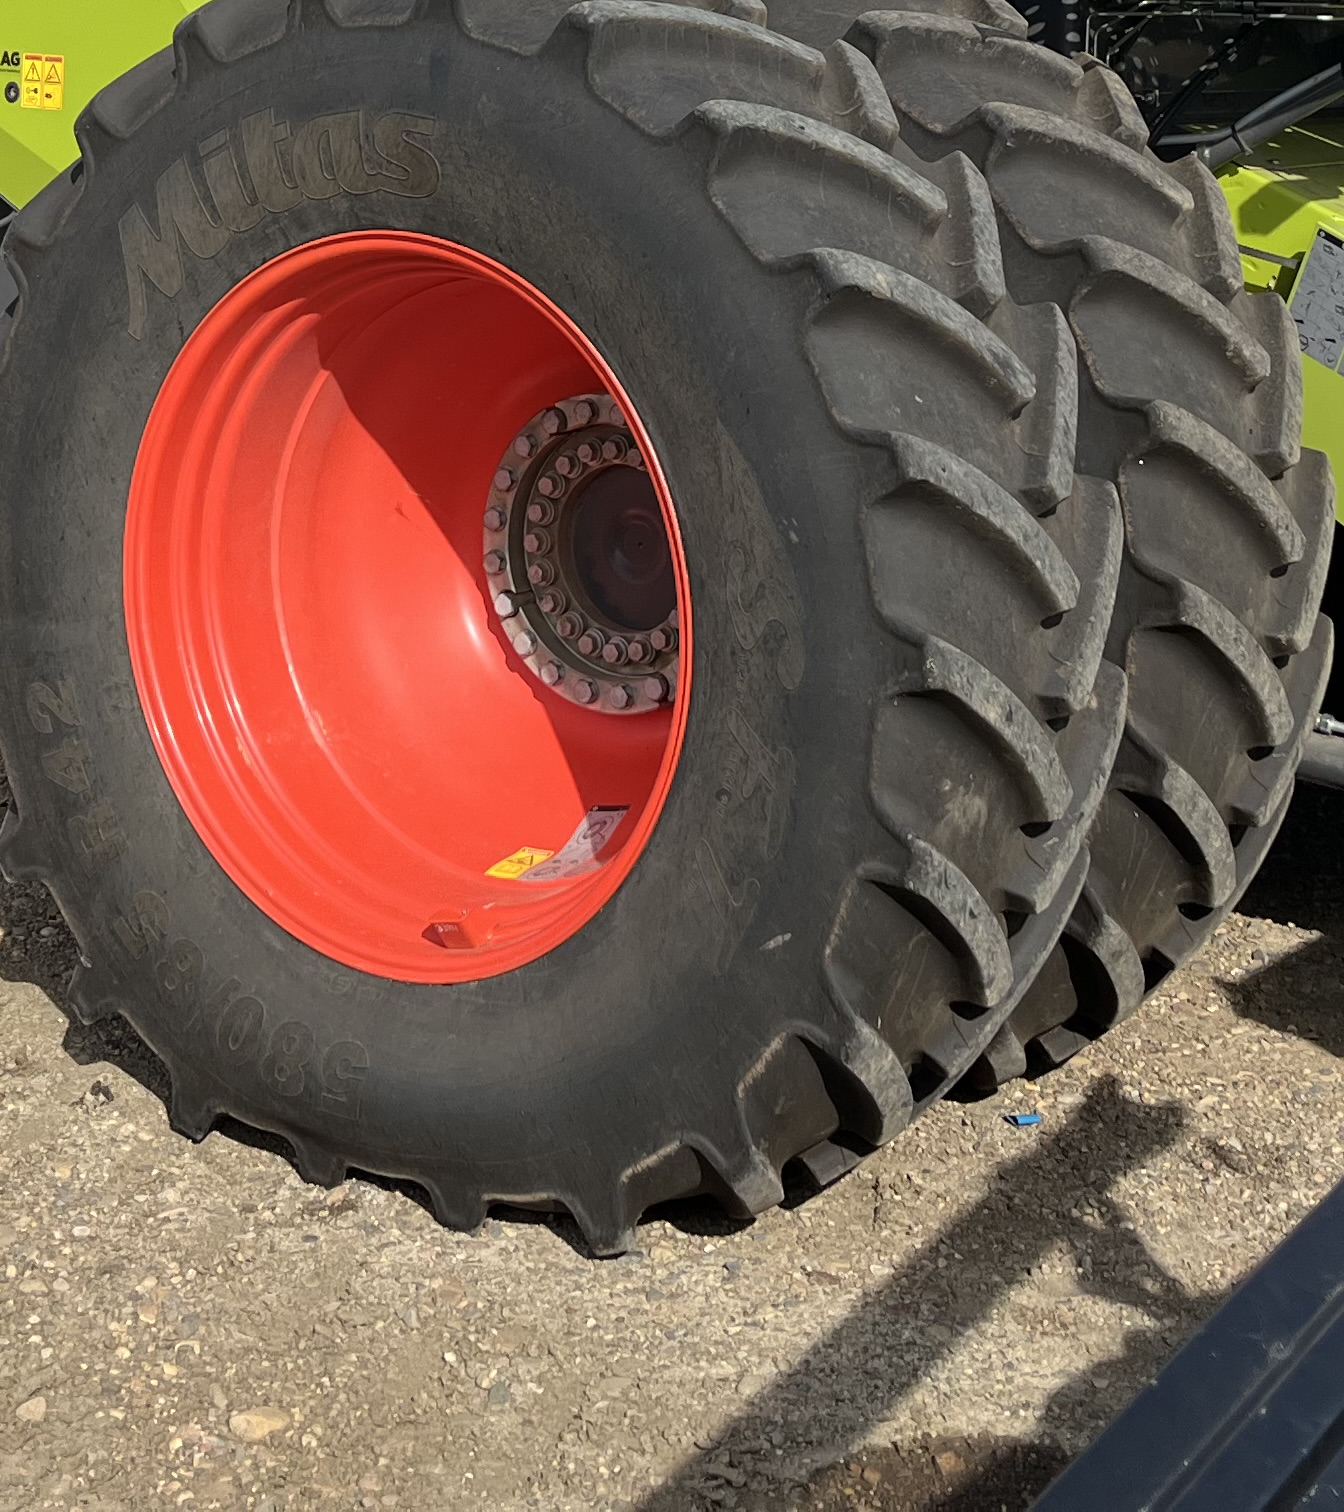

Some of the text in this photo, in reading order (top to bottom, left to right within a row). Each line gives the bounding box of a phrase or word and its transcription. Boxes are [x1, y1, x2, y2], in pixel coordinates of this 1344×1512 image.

[0, 50, 21, 67] AG
[118, 105, 442, 341] Mitas
[25, 674, 93, 795] 42
